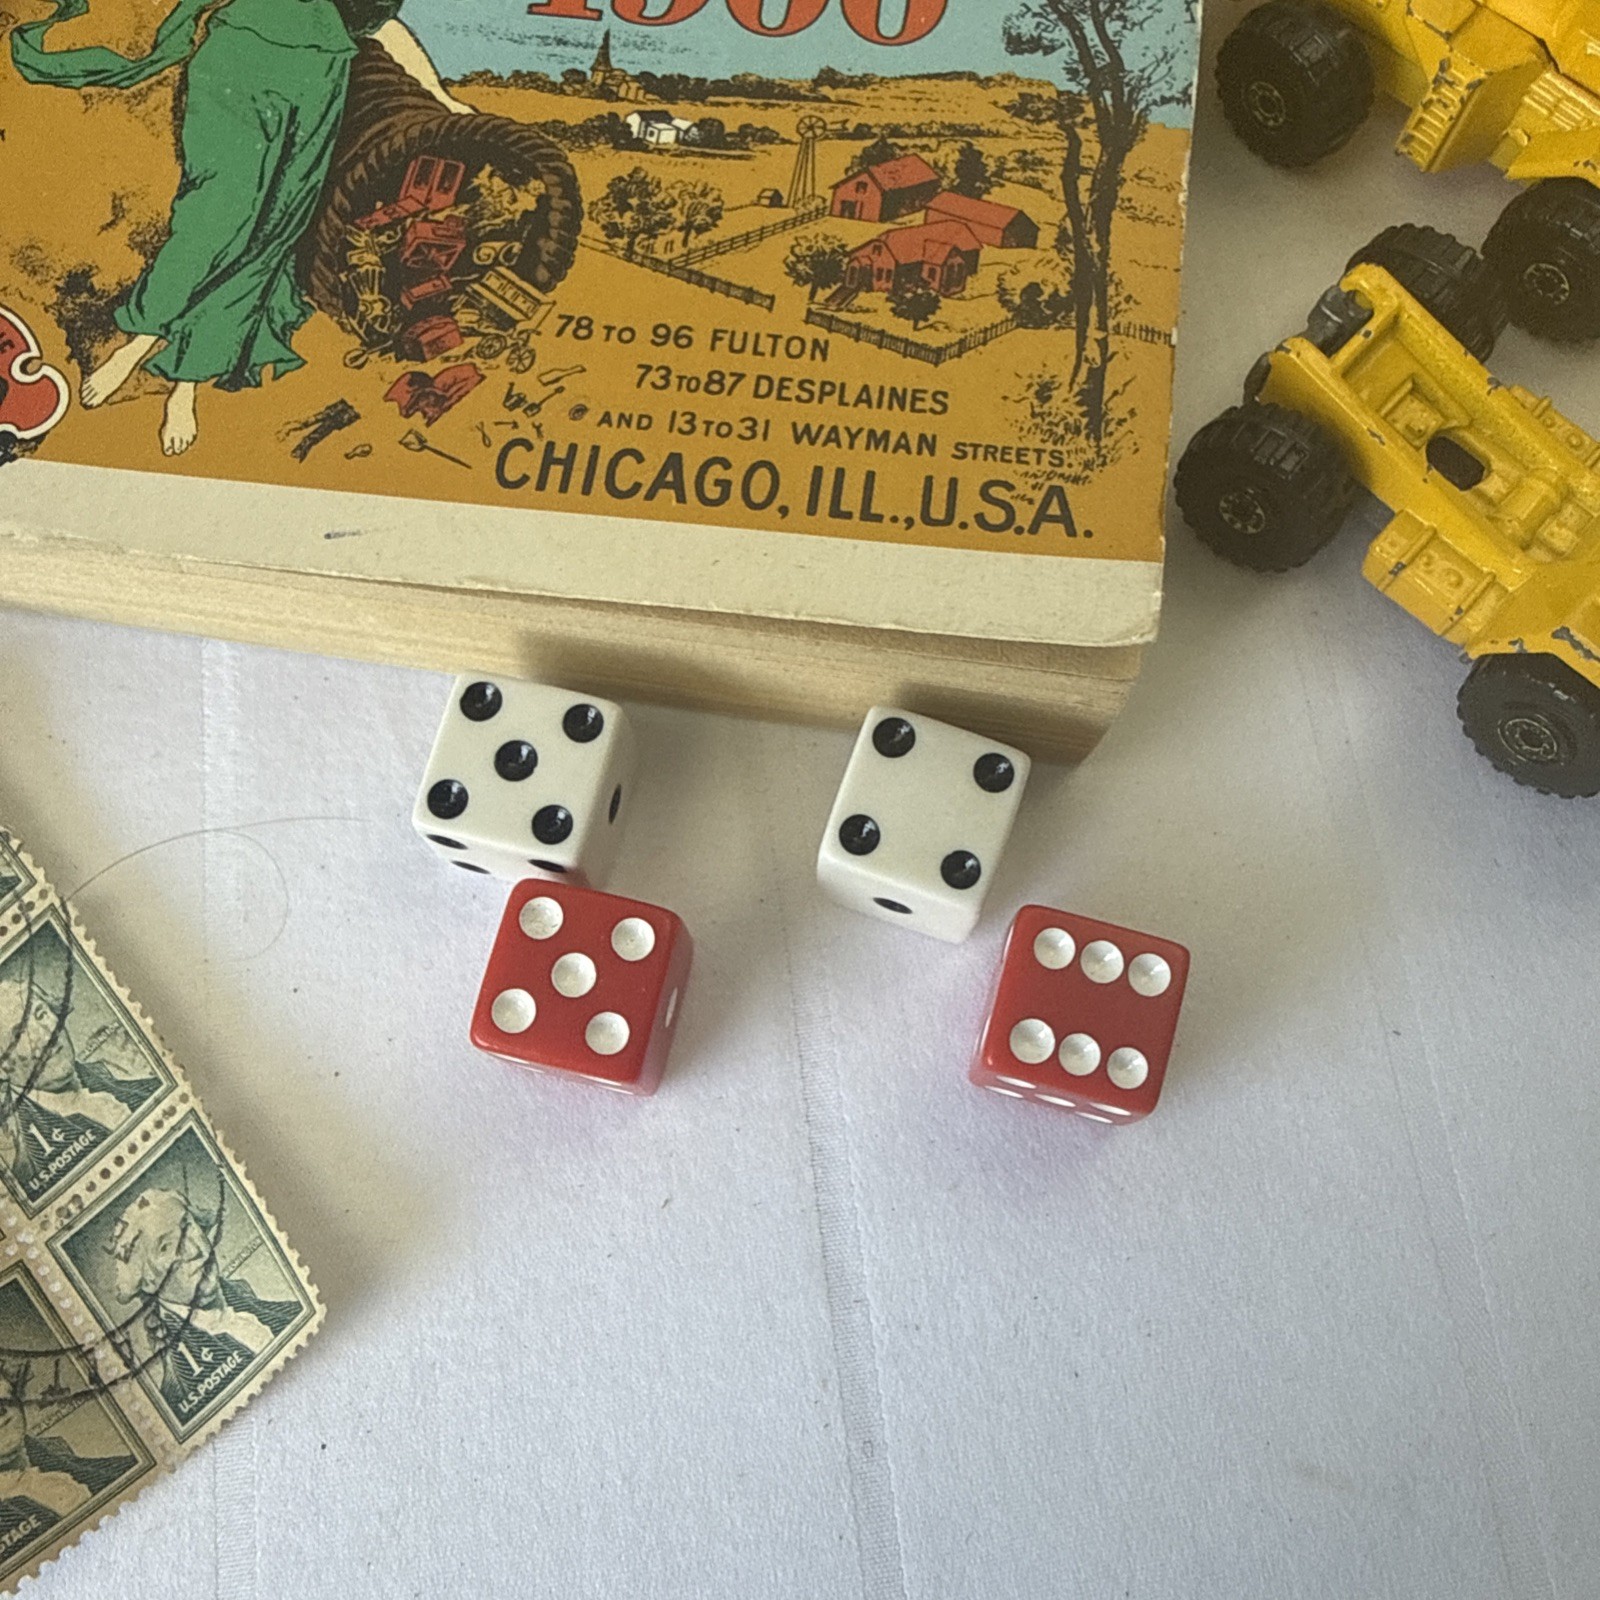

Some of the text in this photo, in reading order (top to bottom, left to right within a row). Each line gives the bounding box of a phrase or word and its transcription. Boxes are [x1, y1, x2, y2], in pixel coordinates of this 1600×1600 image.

[555, 314, 830, 362] 78 TO 96 FULTON
[635, 364, 950, 415] 73 TO 87 DESPLAINES
[597, 410, 653, 431] AND
[668, 410, 697, 436] 13
[702, 420, 733, 439] TO
[736, 416, 770, 442] 31
[791, 421, 937, 457] WAYMAN
[495, 437, 790, 519] CHICAGO,
[920, 474, 1094, 539] U.S.A.
